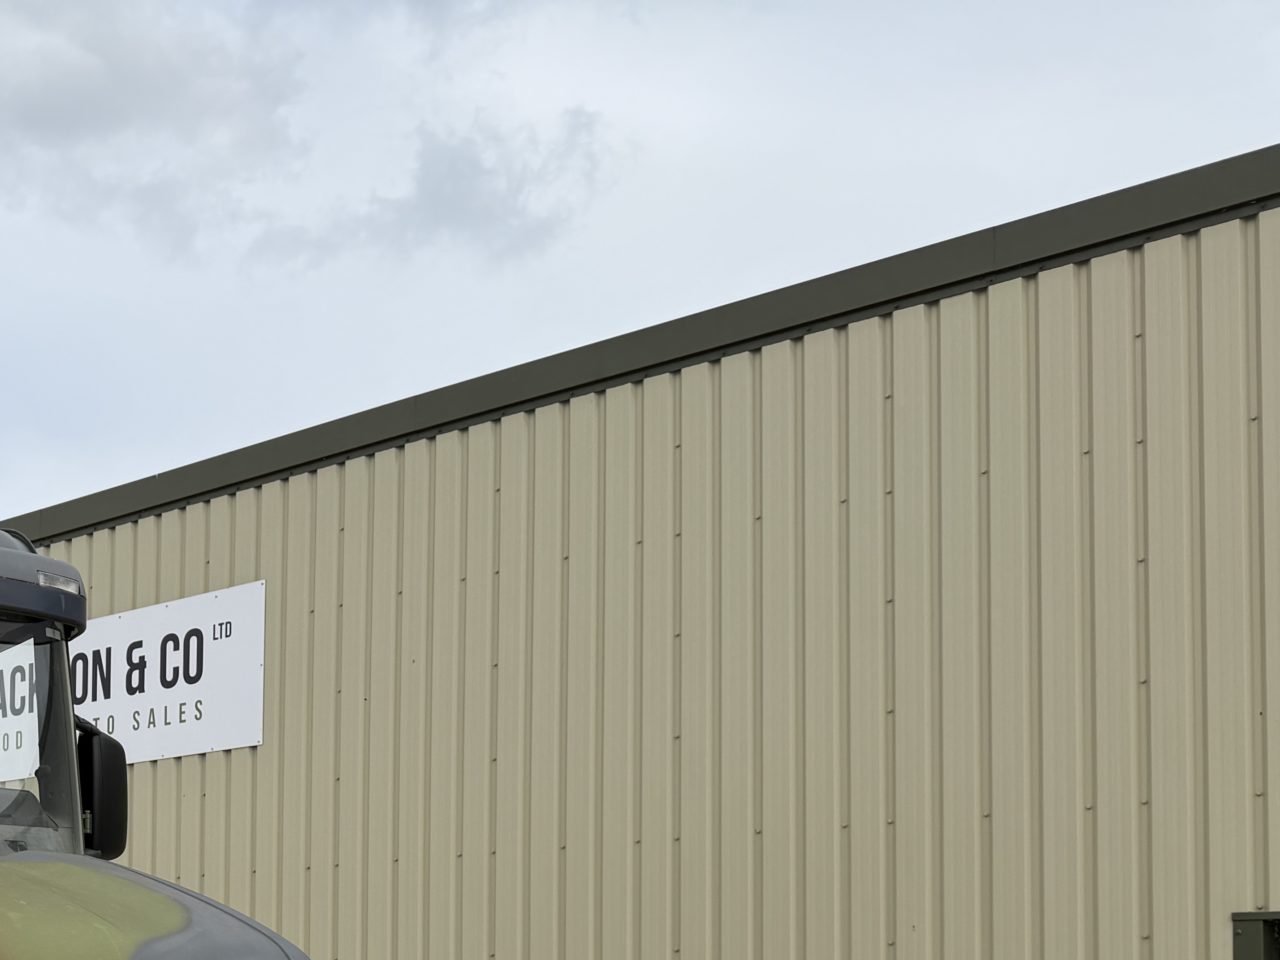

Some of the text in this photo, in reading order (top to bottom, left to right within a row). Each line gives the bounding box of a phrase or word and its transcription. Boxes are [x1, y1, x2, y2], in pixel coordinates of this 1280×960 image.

[125, 640, 147, 696] &
[159, 628, 204, 689] CO
[212, 621, 232, 641] LTD
[132, 699, 203, 731] SALES
